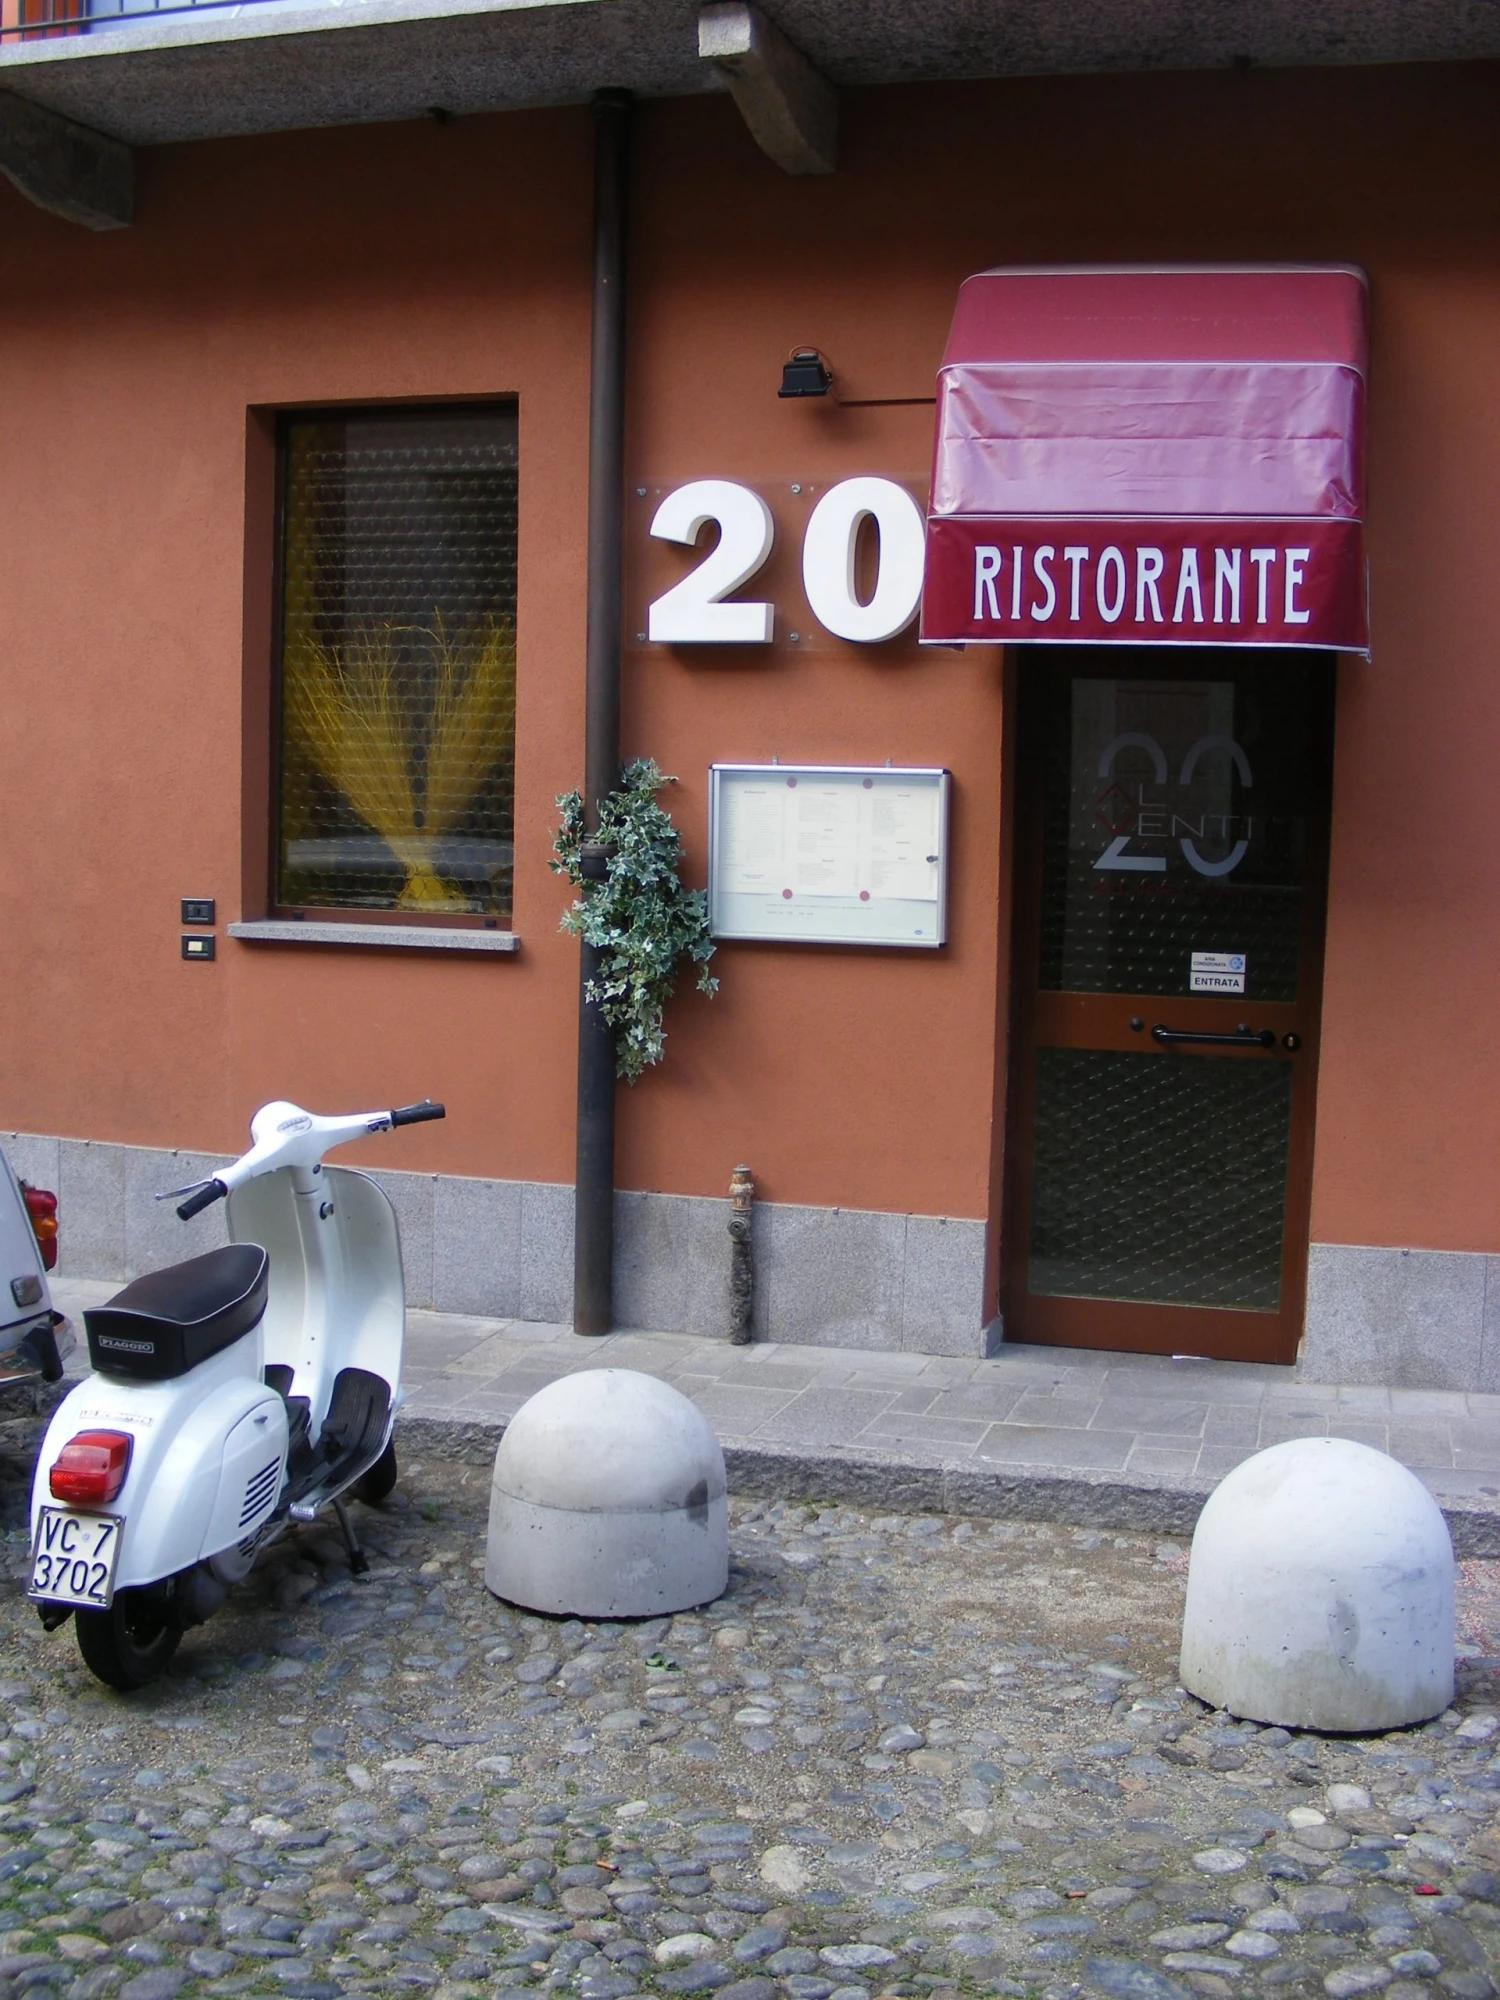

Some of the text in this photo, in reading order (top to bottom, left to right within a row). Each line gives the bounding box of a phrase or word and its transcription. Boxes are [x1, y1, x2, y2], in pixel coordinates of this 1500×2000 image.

[648, 476, 926, 643] 20
[973, 545, 1311, 624] RISTORANTE
[1194, 977, 1240, 987] ENTRATA
[102, 1338, 151, 1351] PIAGGIO
[46, 1516, 114, 1557] VC 7
[34, 1554, 108, 1599] 3702
